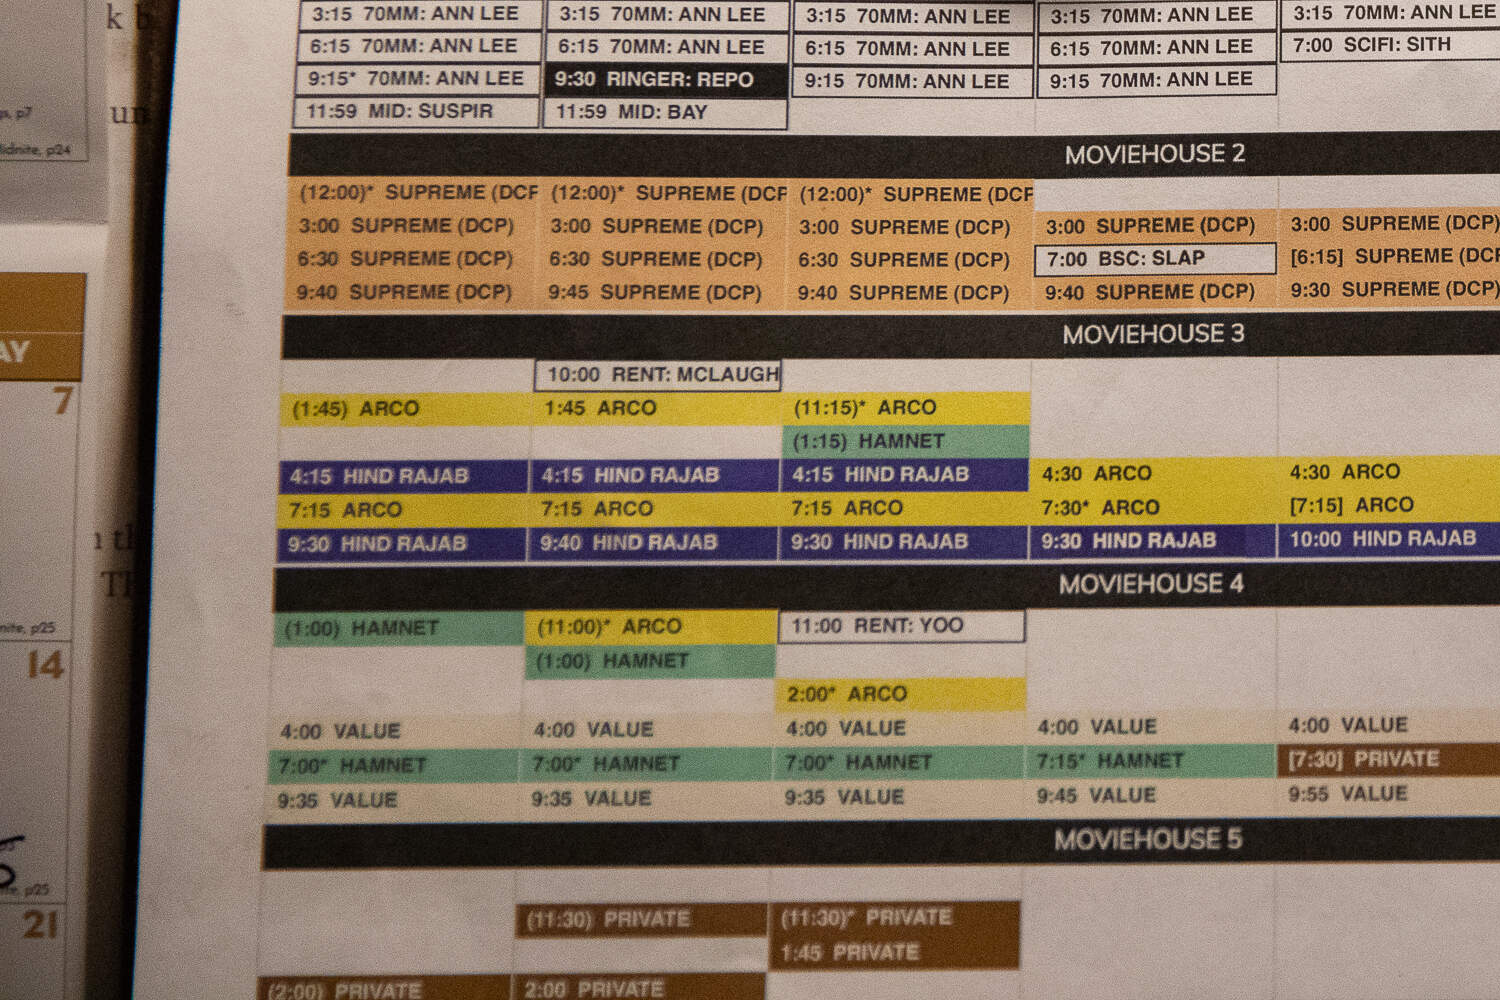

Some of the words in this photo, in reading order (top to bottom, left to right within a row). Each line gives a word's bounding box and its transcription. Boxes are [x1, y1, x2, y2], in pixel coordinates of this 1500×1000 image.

[1294, 38, 1332, 52] 7:00
[1345, 37, 1400, 52] SCIFI:
[1407, 36, 1451, 51] SITH
[556, 71, 596, 86] 9:30
[608, 72, 690, 86] RINGER:
[698, 72, 754, 87] REPO
[308, 104, 357, 118] 11:59
[370, 103, 411, 118] MID:
[419, 103, 493, 118] SUSPIR
[559, 105, 607, 119] 11:59
[619, 105, 660, 119] MID:
[668, 105, 707, 119] BAY
[1066, 144, 1224, 164] MOVIEHOUSE
[1233, 143, 1245, 162] 2
[300, 218, 339, 233] 3:00
[353, 217, 451, 233] SUPREME
[458, 218, 513, 235] (DCP)
[1048, 252, 1087, 267] 7:00
[1099, 251, 1145, 266] BSC:
[1153, 250, 1205, 266] SLAP
[1064, 324, 1223, 344] MOVIEHOUSE
[1232, 323, 1245, 343] 3
[548, 366, 600, 384] 10:00
[612, 366, 671, 384] RENT:
[677, 366, 779, 384] MCLAUGH
[54, 387, 73, 415] 7
[878, 399, 937, 415] ARCO
[291, 469, 332, 485] 4:15
[344, 469, 394, 483] HIND
[400, 468, 470, 483] RAJAB
[1042, 534, 1081, 549] 9:30
[1093, 534, 1141, 549] HIND
[1148, 533, 1216, 550] RAJAB
[1060, 573, 1222, 593] MOVIEHOUSE
[1230, 573, 1244, 592] 4
[285, 619, 339, 638] (1:00)
[352, 619, 440, 638] HAMNET
[792, 617, 842, 635] 11:00
[854, 617, 913, 635] RENT:
[921, 617, 963, 635] YOO
[30, 651, 64, 679] 14
[1289, 717, 1330, 732] 4:00
[1342, 716, 1407, 732] VALUE
[1289, 751, 1343, 770] [7:30]
[1355, 750, 1440, 767] PRIVATE
[1055, 830, 1218, 850] MOVIEHOUSE
[1228, 828, 1243, 849] 5
[24, 910, 57, 938] 21
[528, 912, 593, 929] (11:30)
[605, 910, 690, 927] PRIVATE
